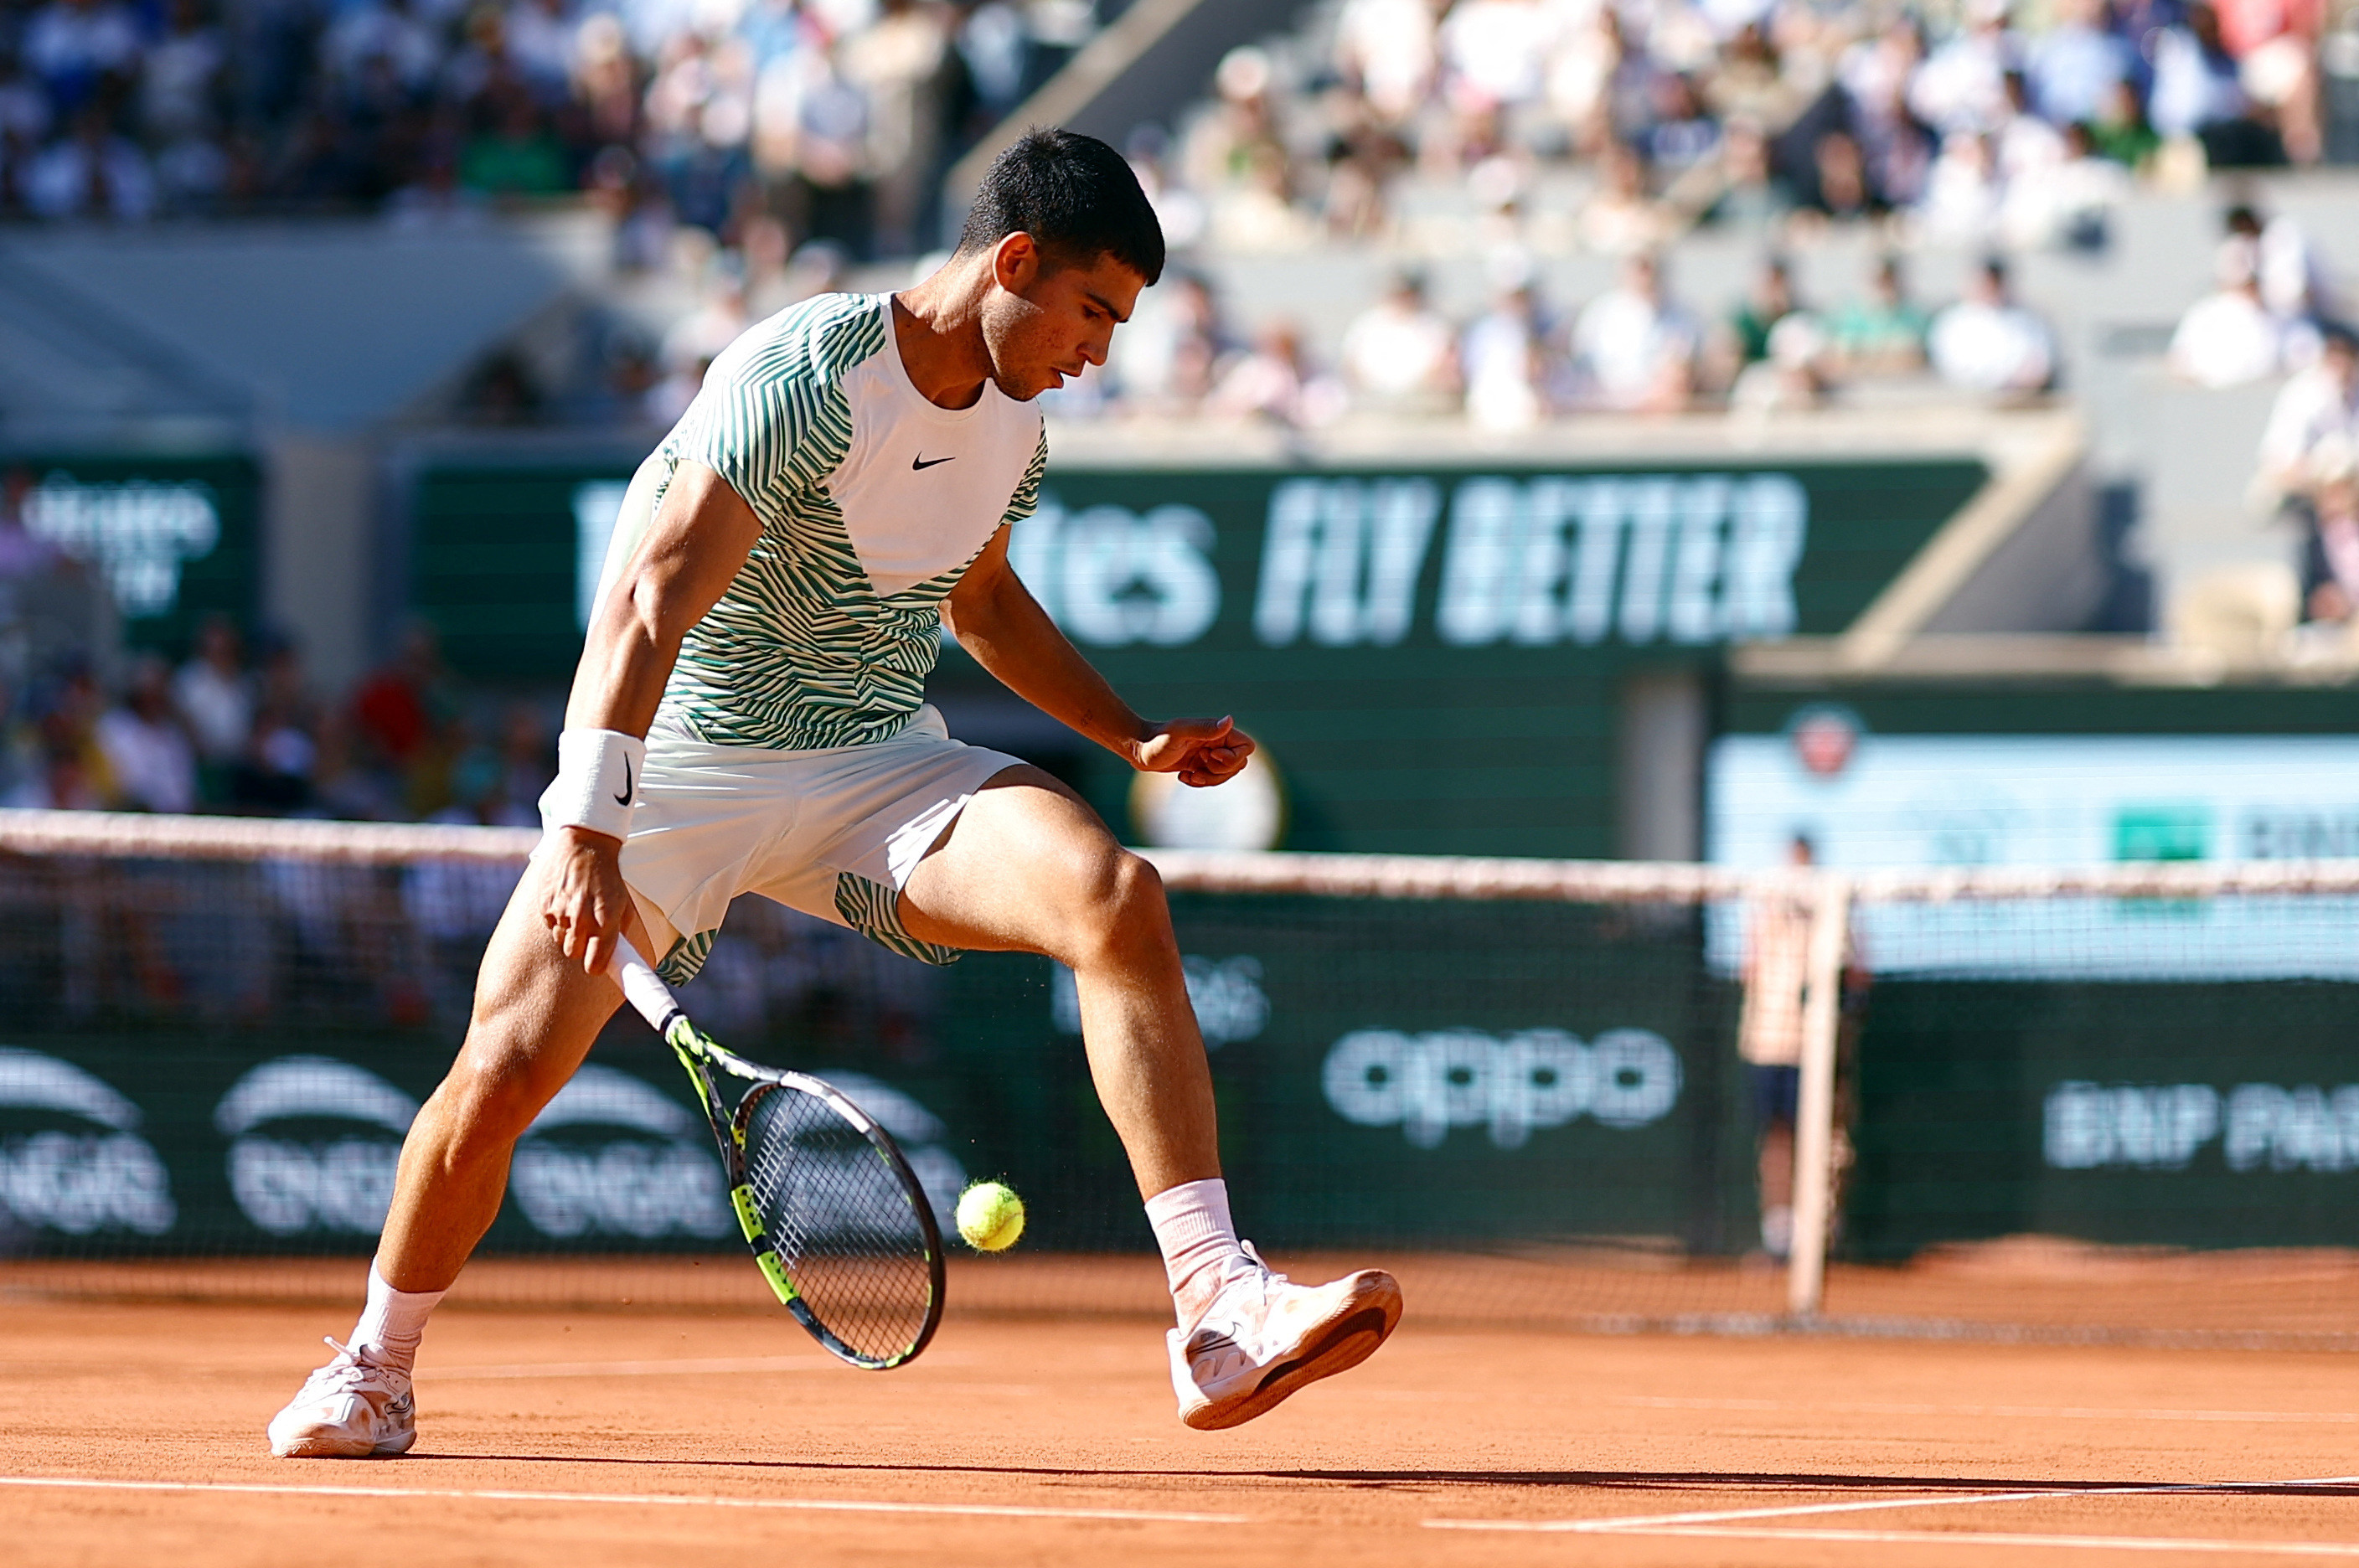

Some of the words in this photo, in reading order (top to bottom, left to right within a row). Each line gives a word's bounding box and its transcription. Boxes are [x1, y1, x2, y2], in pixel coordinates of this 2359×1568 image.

[1253, 479, 1438, 643] FLY
[1436, 476, 1806, 643] BETTER
[1324, 1029, 1680, 1148] oppo
